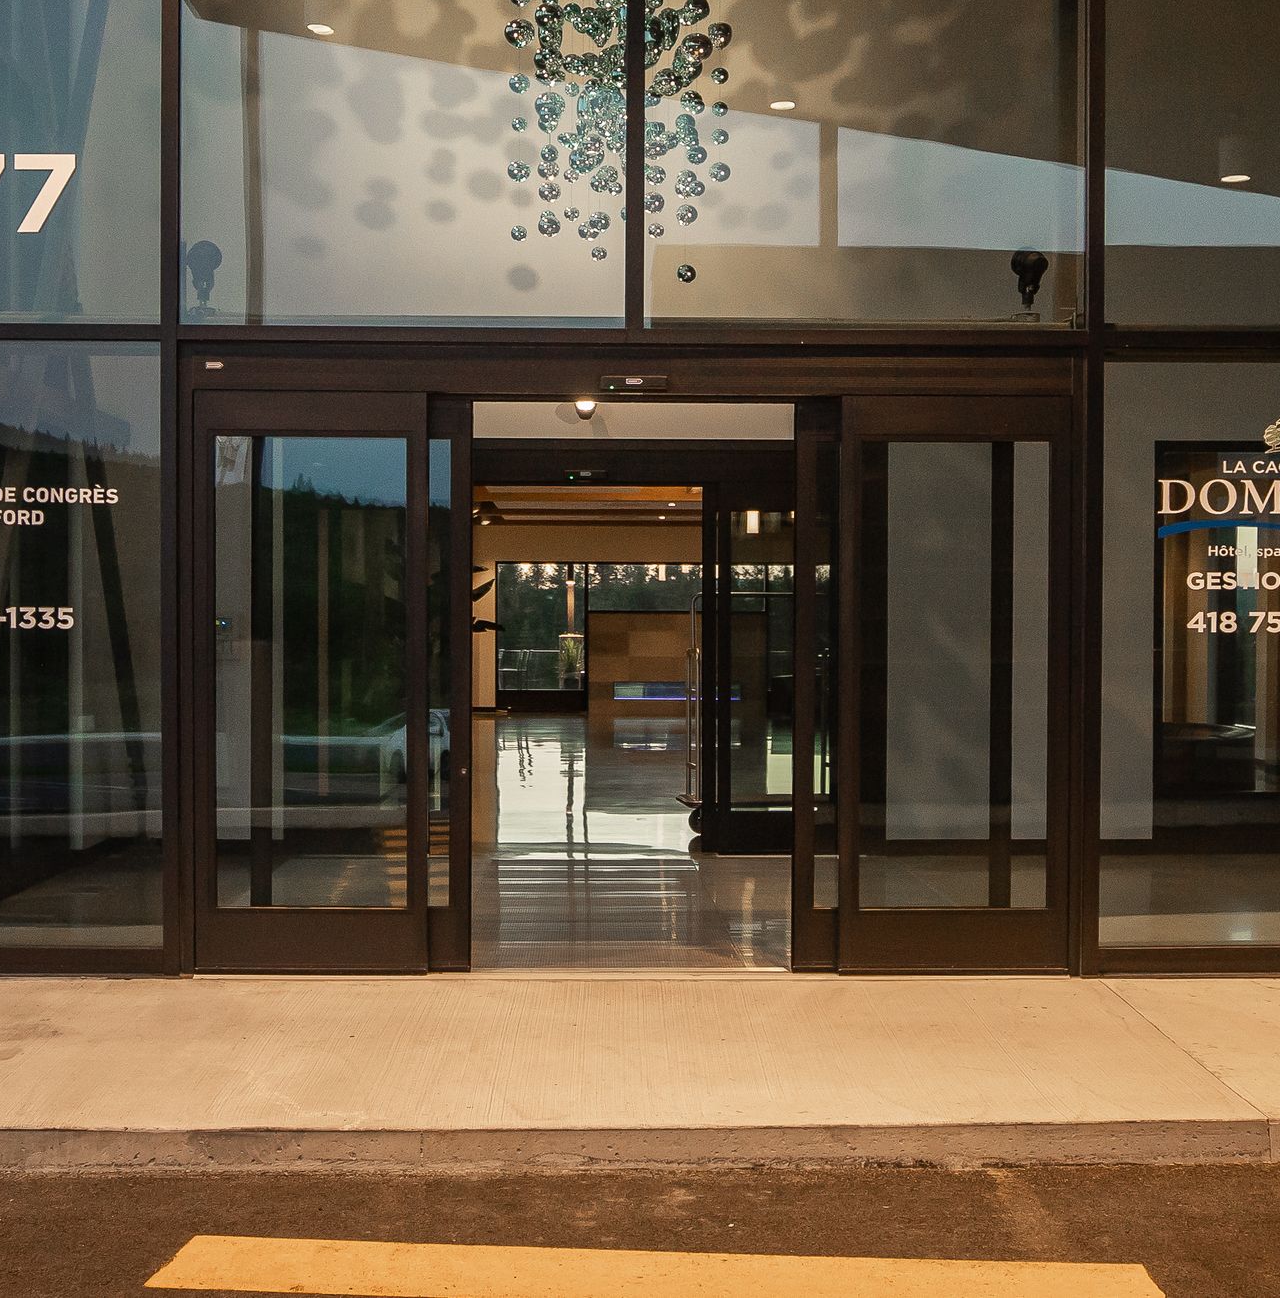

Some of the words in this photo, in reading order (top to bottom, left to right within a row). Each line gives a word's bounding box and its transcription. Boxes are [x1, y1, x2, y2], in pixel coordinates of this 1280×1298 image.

[1222, 460, 1247, 474] LA
[22, 483, 119, 505] CONGRÈS
[1207, 544, 1252, 558] Hôtel,
[1186, 611, 1238, 634] 418
